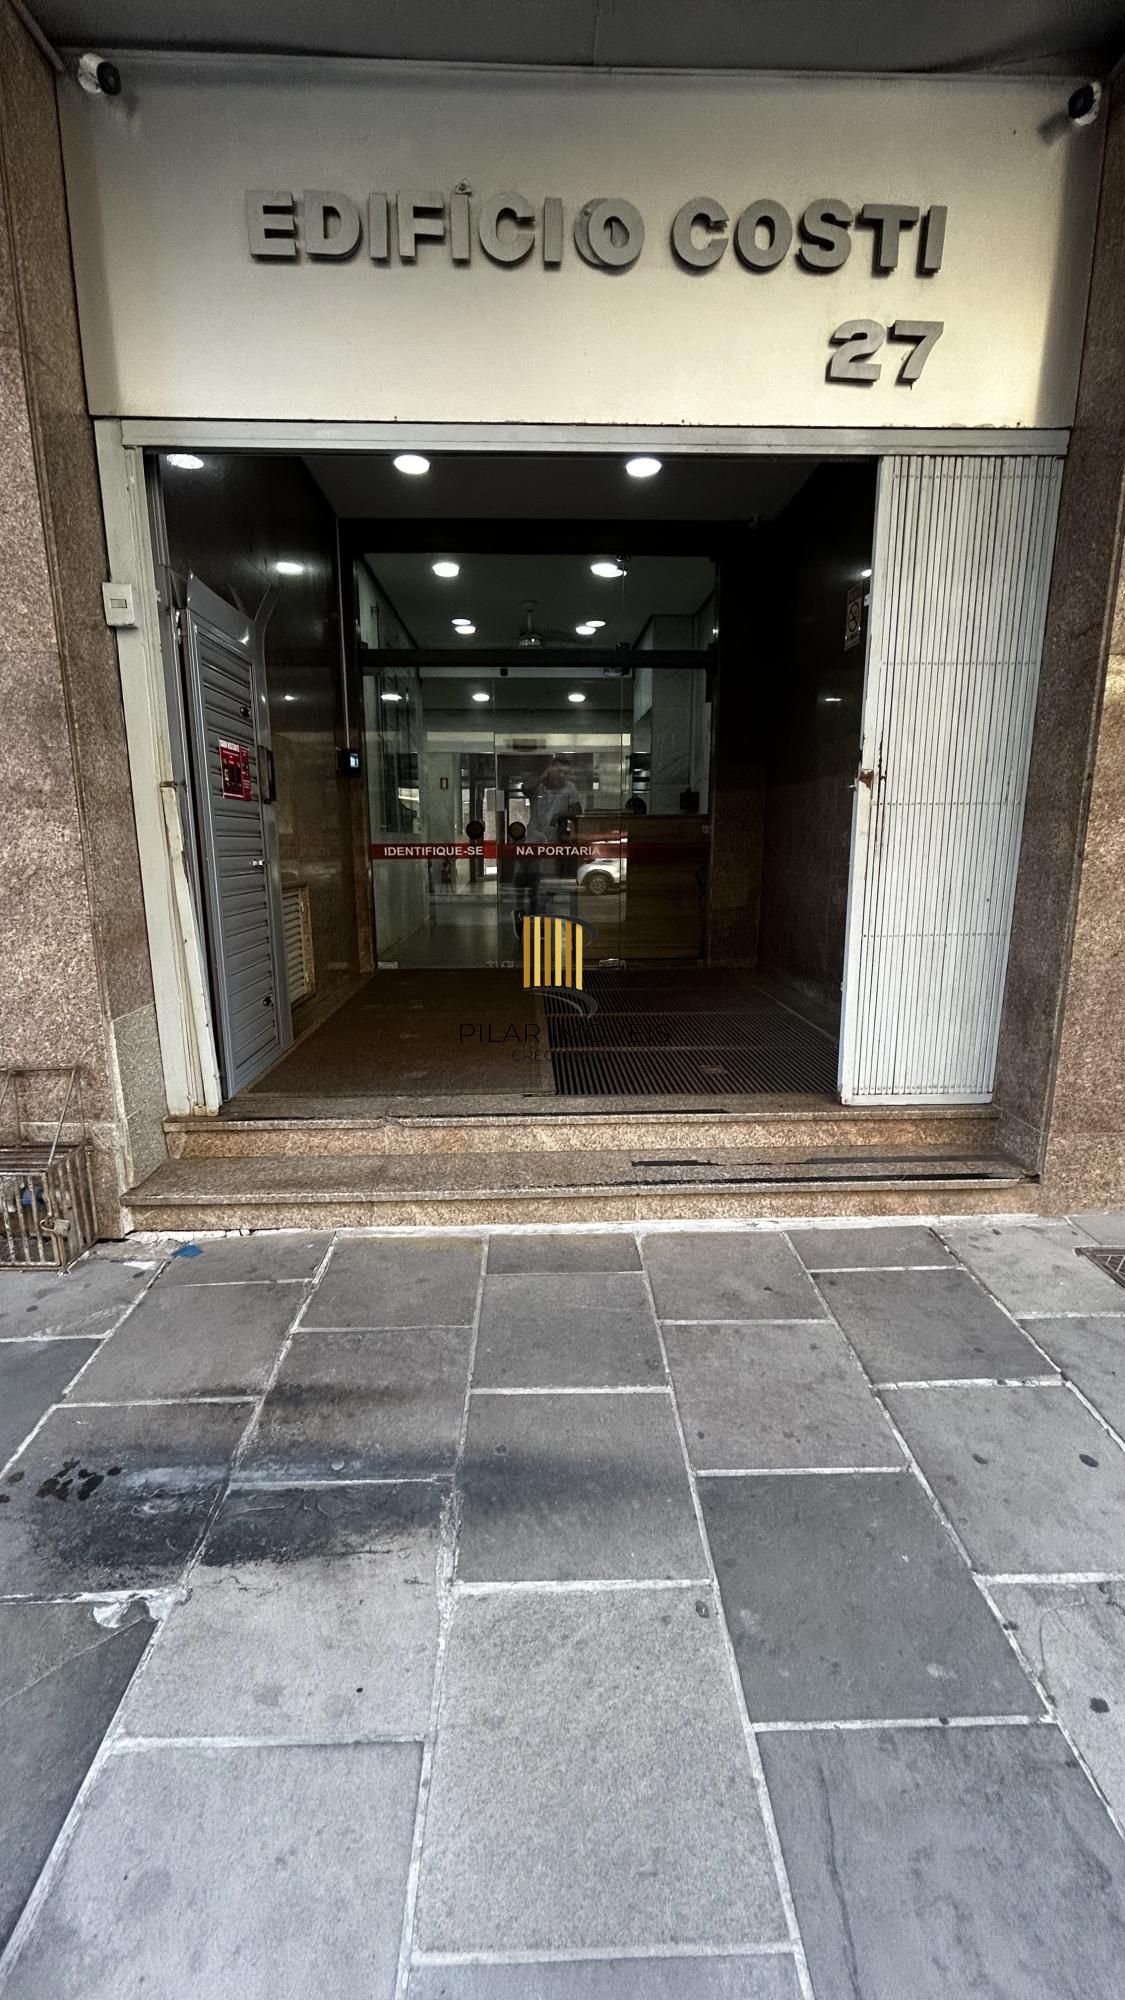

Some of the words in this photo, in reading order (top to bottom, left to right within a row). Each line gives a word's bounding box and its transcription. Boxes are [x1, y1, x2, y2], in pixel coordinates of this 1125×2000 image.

[671, 196, 948, 273] COSTI
[828, 318, 945, 386] 27
[383, 845, 484, 857] IDENTIFIQUE-SE
[515, 845, 535, 857] NA
[537, 845, 601, 857] PORTARIA
